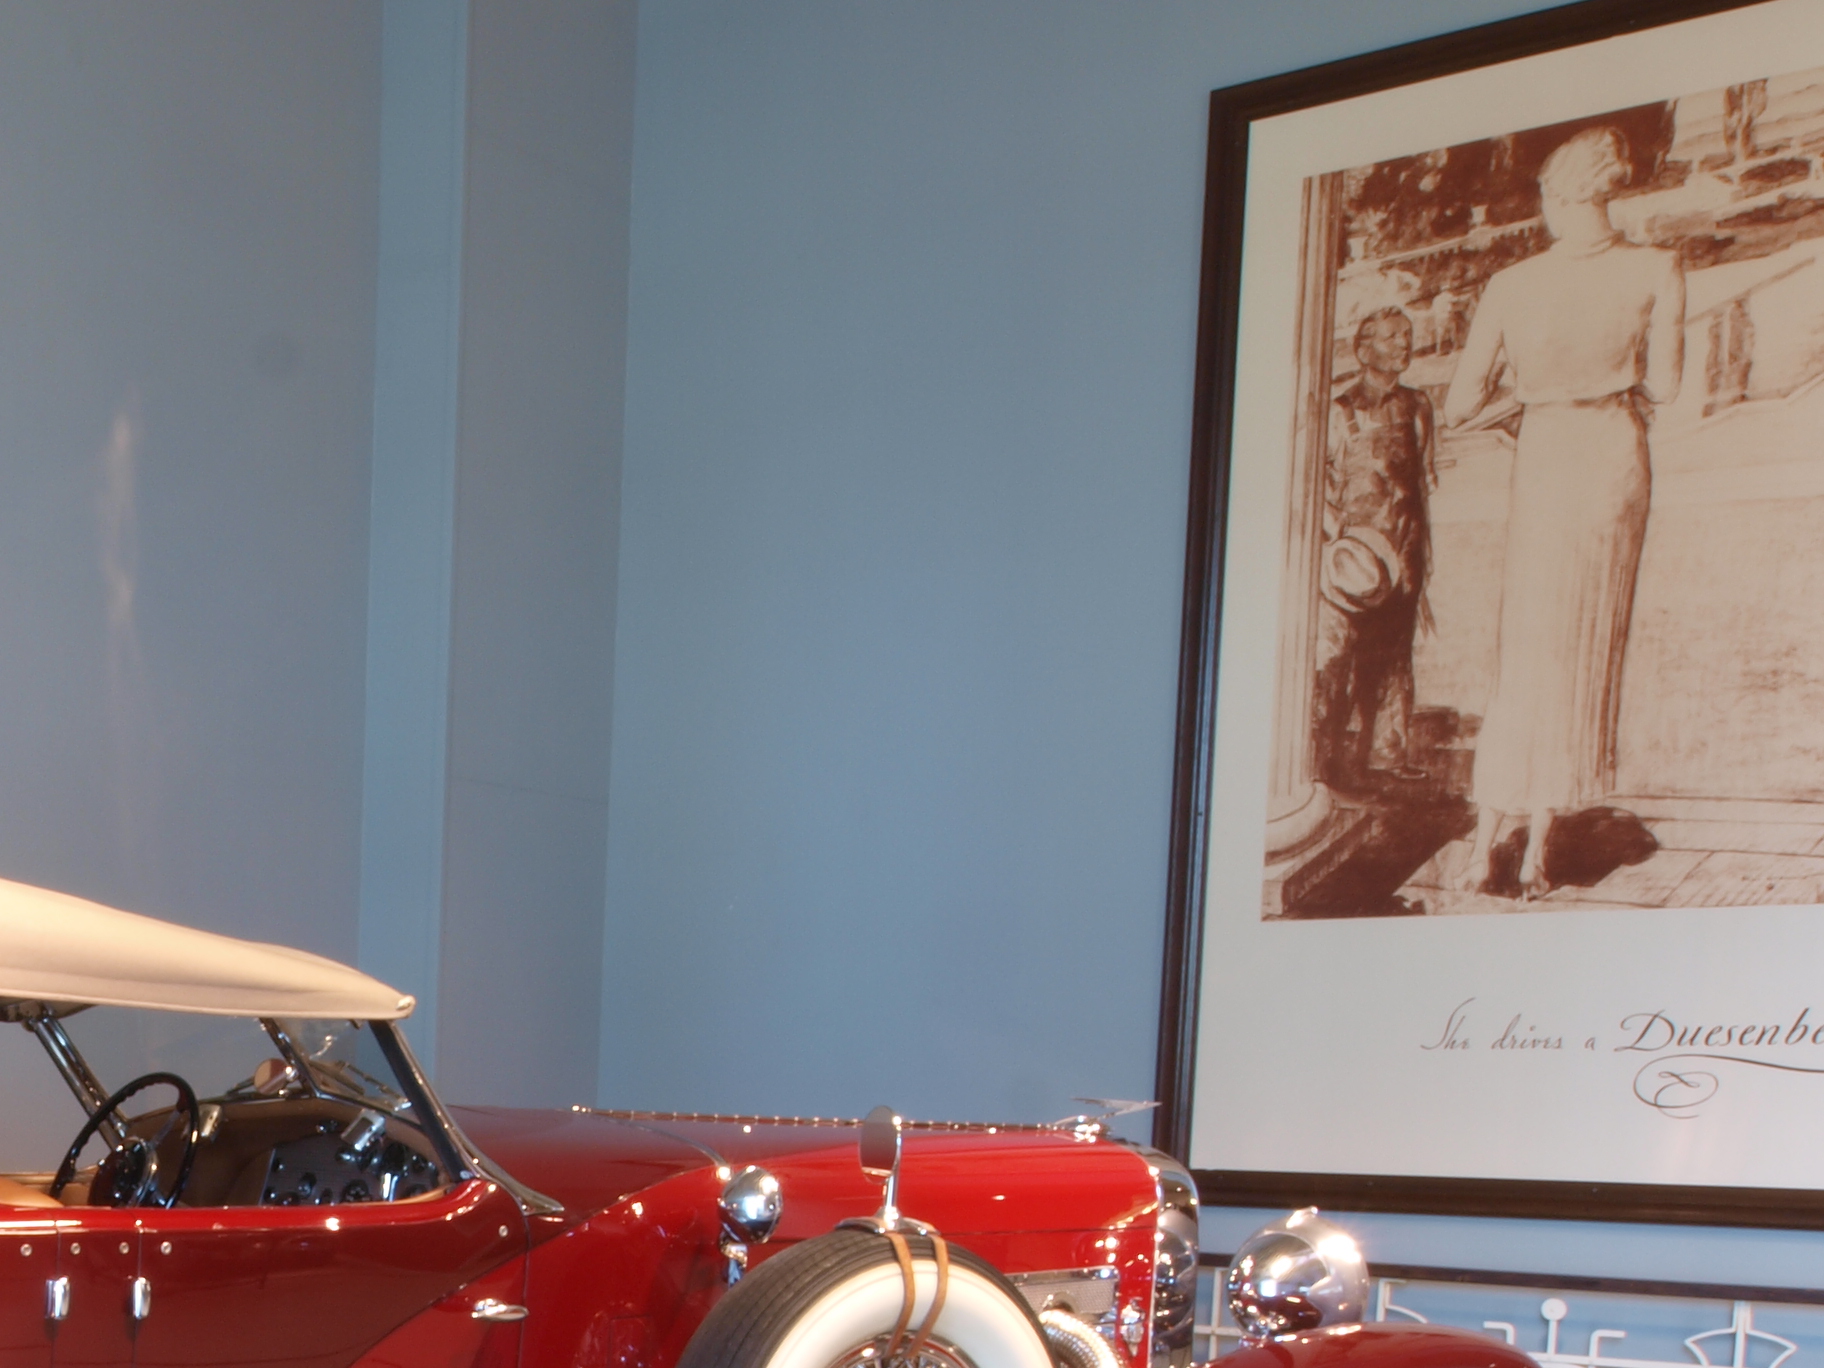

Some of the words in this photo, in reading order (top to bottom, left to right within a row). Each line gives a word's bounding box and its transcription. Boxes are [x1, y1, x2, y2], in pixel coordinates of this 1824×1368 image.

[1420, 997, 1476, 1050] She
[1491, 1013, 1563, 1050] drives
[1584, 1037, 1596, 1050] a
